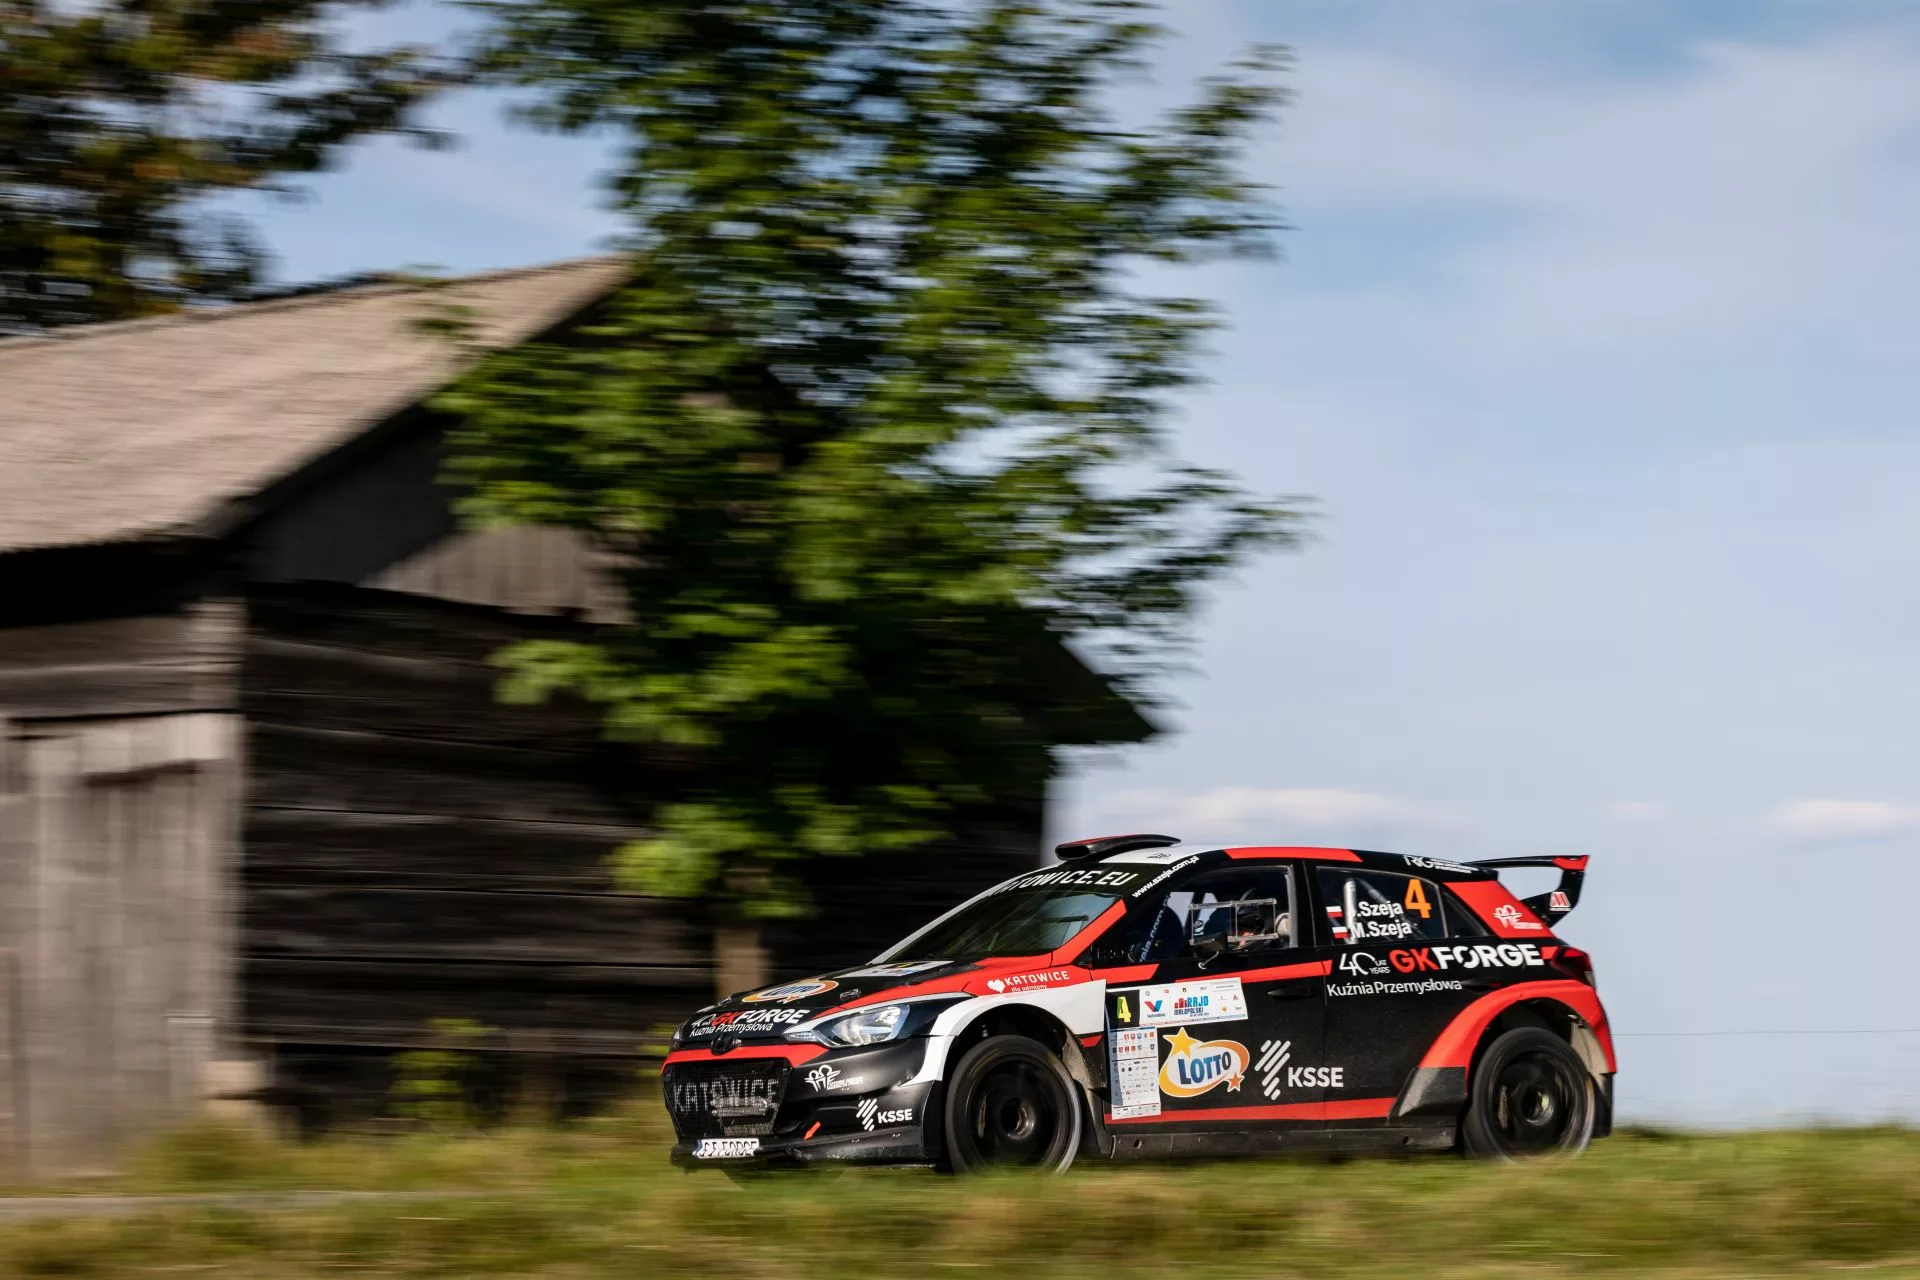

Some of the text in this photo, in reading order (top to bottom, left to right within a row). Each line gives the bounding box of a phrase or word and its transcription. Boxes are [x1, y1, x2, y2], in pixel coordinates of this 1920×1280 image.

[1132, 856, 1199, 897] www.szeja.com.pl
[1353, 900, 1404, 918] .Szeja
[1405, 878, 1432, 918] 4
[1350, 919, 1412, 938] M.Szeja
[1339, 952, 1375, 976] 40
[1369, 967, 1391, 975] YEARS
[1004, 970, 1070, 986] KATOWICE
[1327, 978, 1463, 997] Kuźnia Przemysłowa
[1117, 996, 1131, 1023] 4
[1178, 1051, 1232, 1085] LOTTO
[1288, 1066, 1344, 1088] KSSE
[673, 1078, 779, 1112] KATOWICE
[877, 1108, 913, 1123] KSSE
